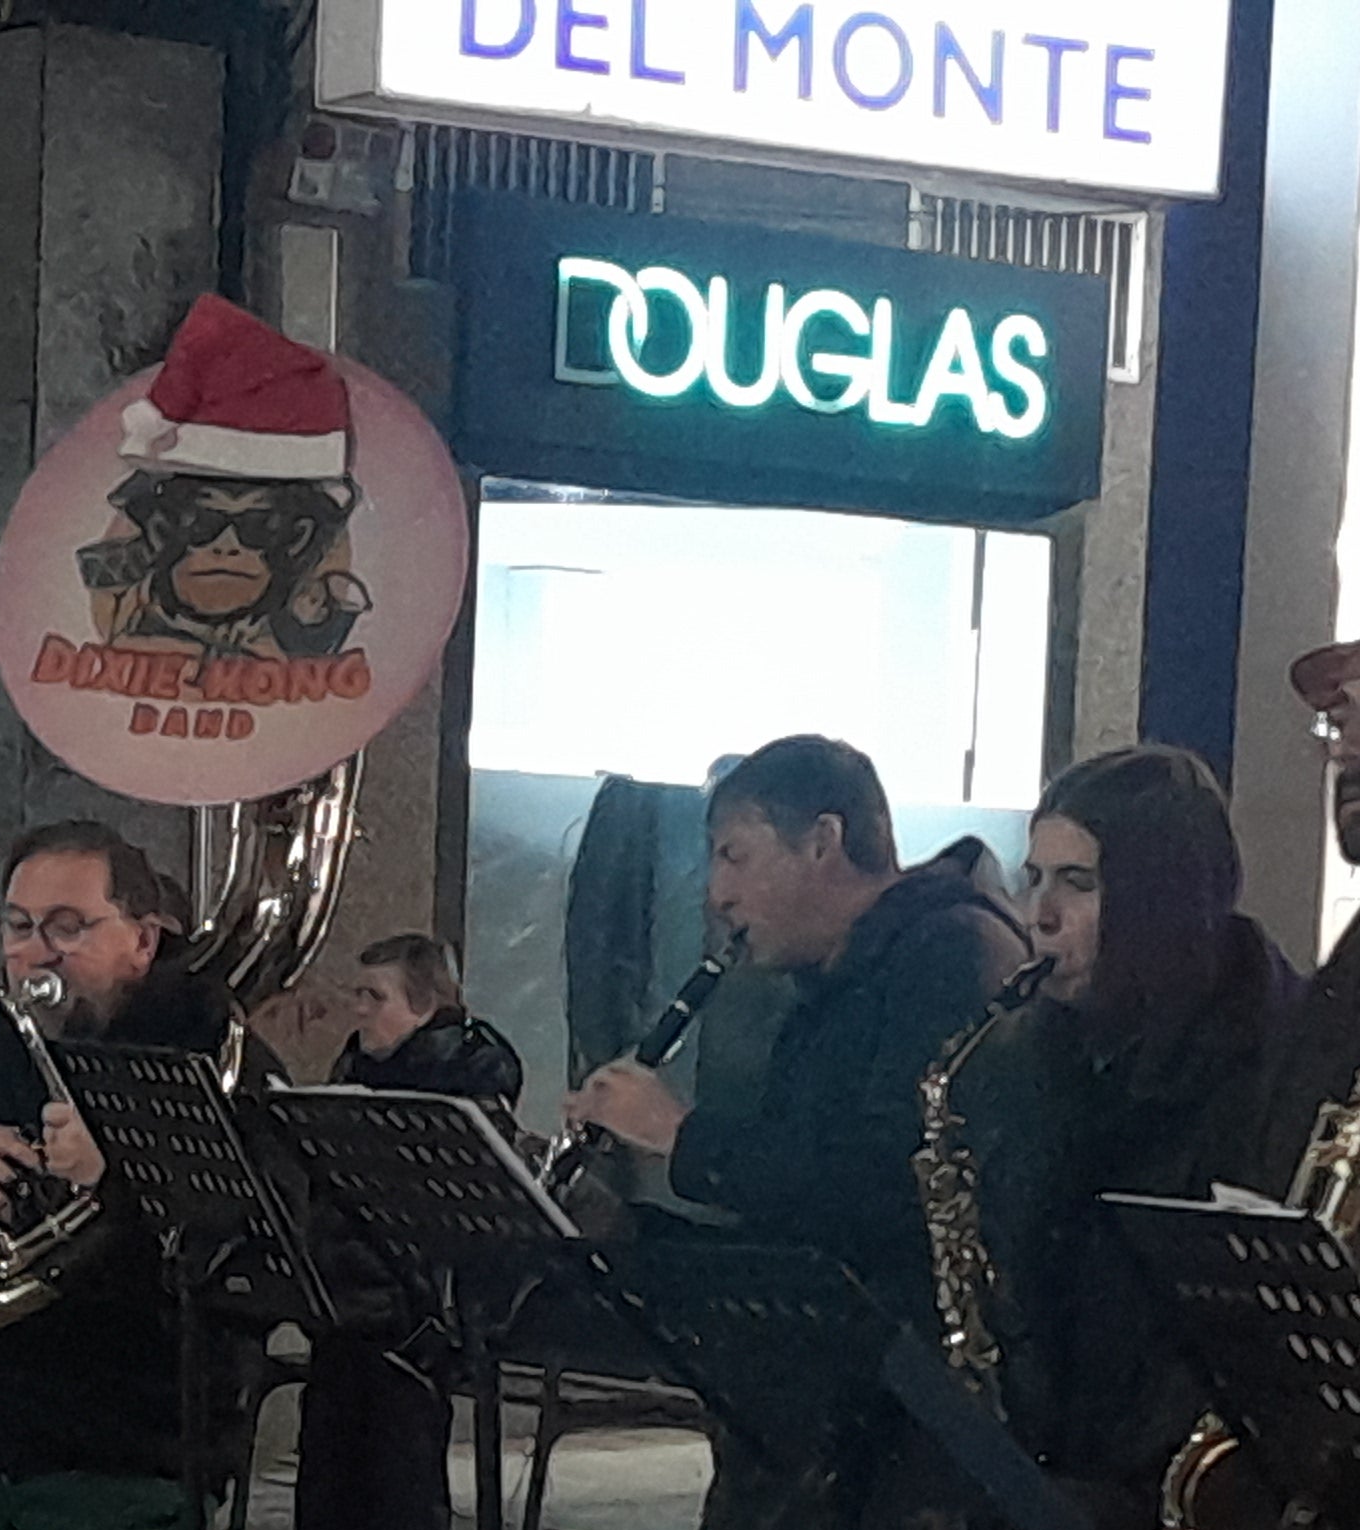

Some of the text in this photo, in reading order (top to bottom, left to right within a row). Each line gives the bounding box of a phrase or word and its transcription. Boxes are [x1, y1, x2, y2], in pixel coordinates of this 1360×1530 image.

[460, 0, 1154, 145] DEL MONTE
[555, 254, 1049, 441] DOUGLAS
[128, 701, 256, 740] BAND
